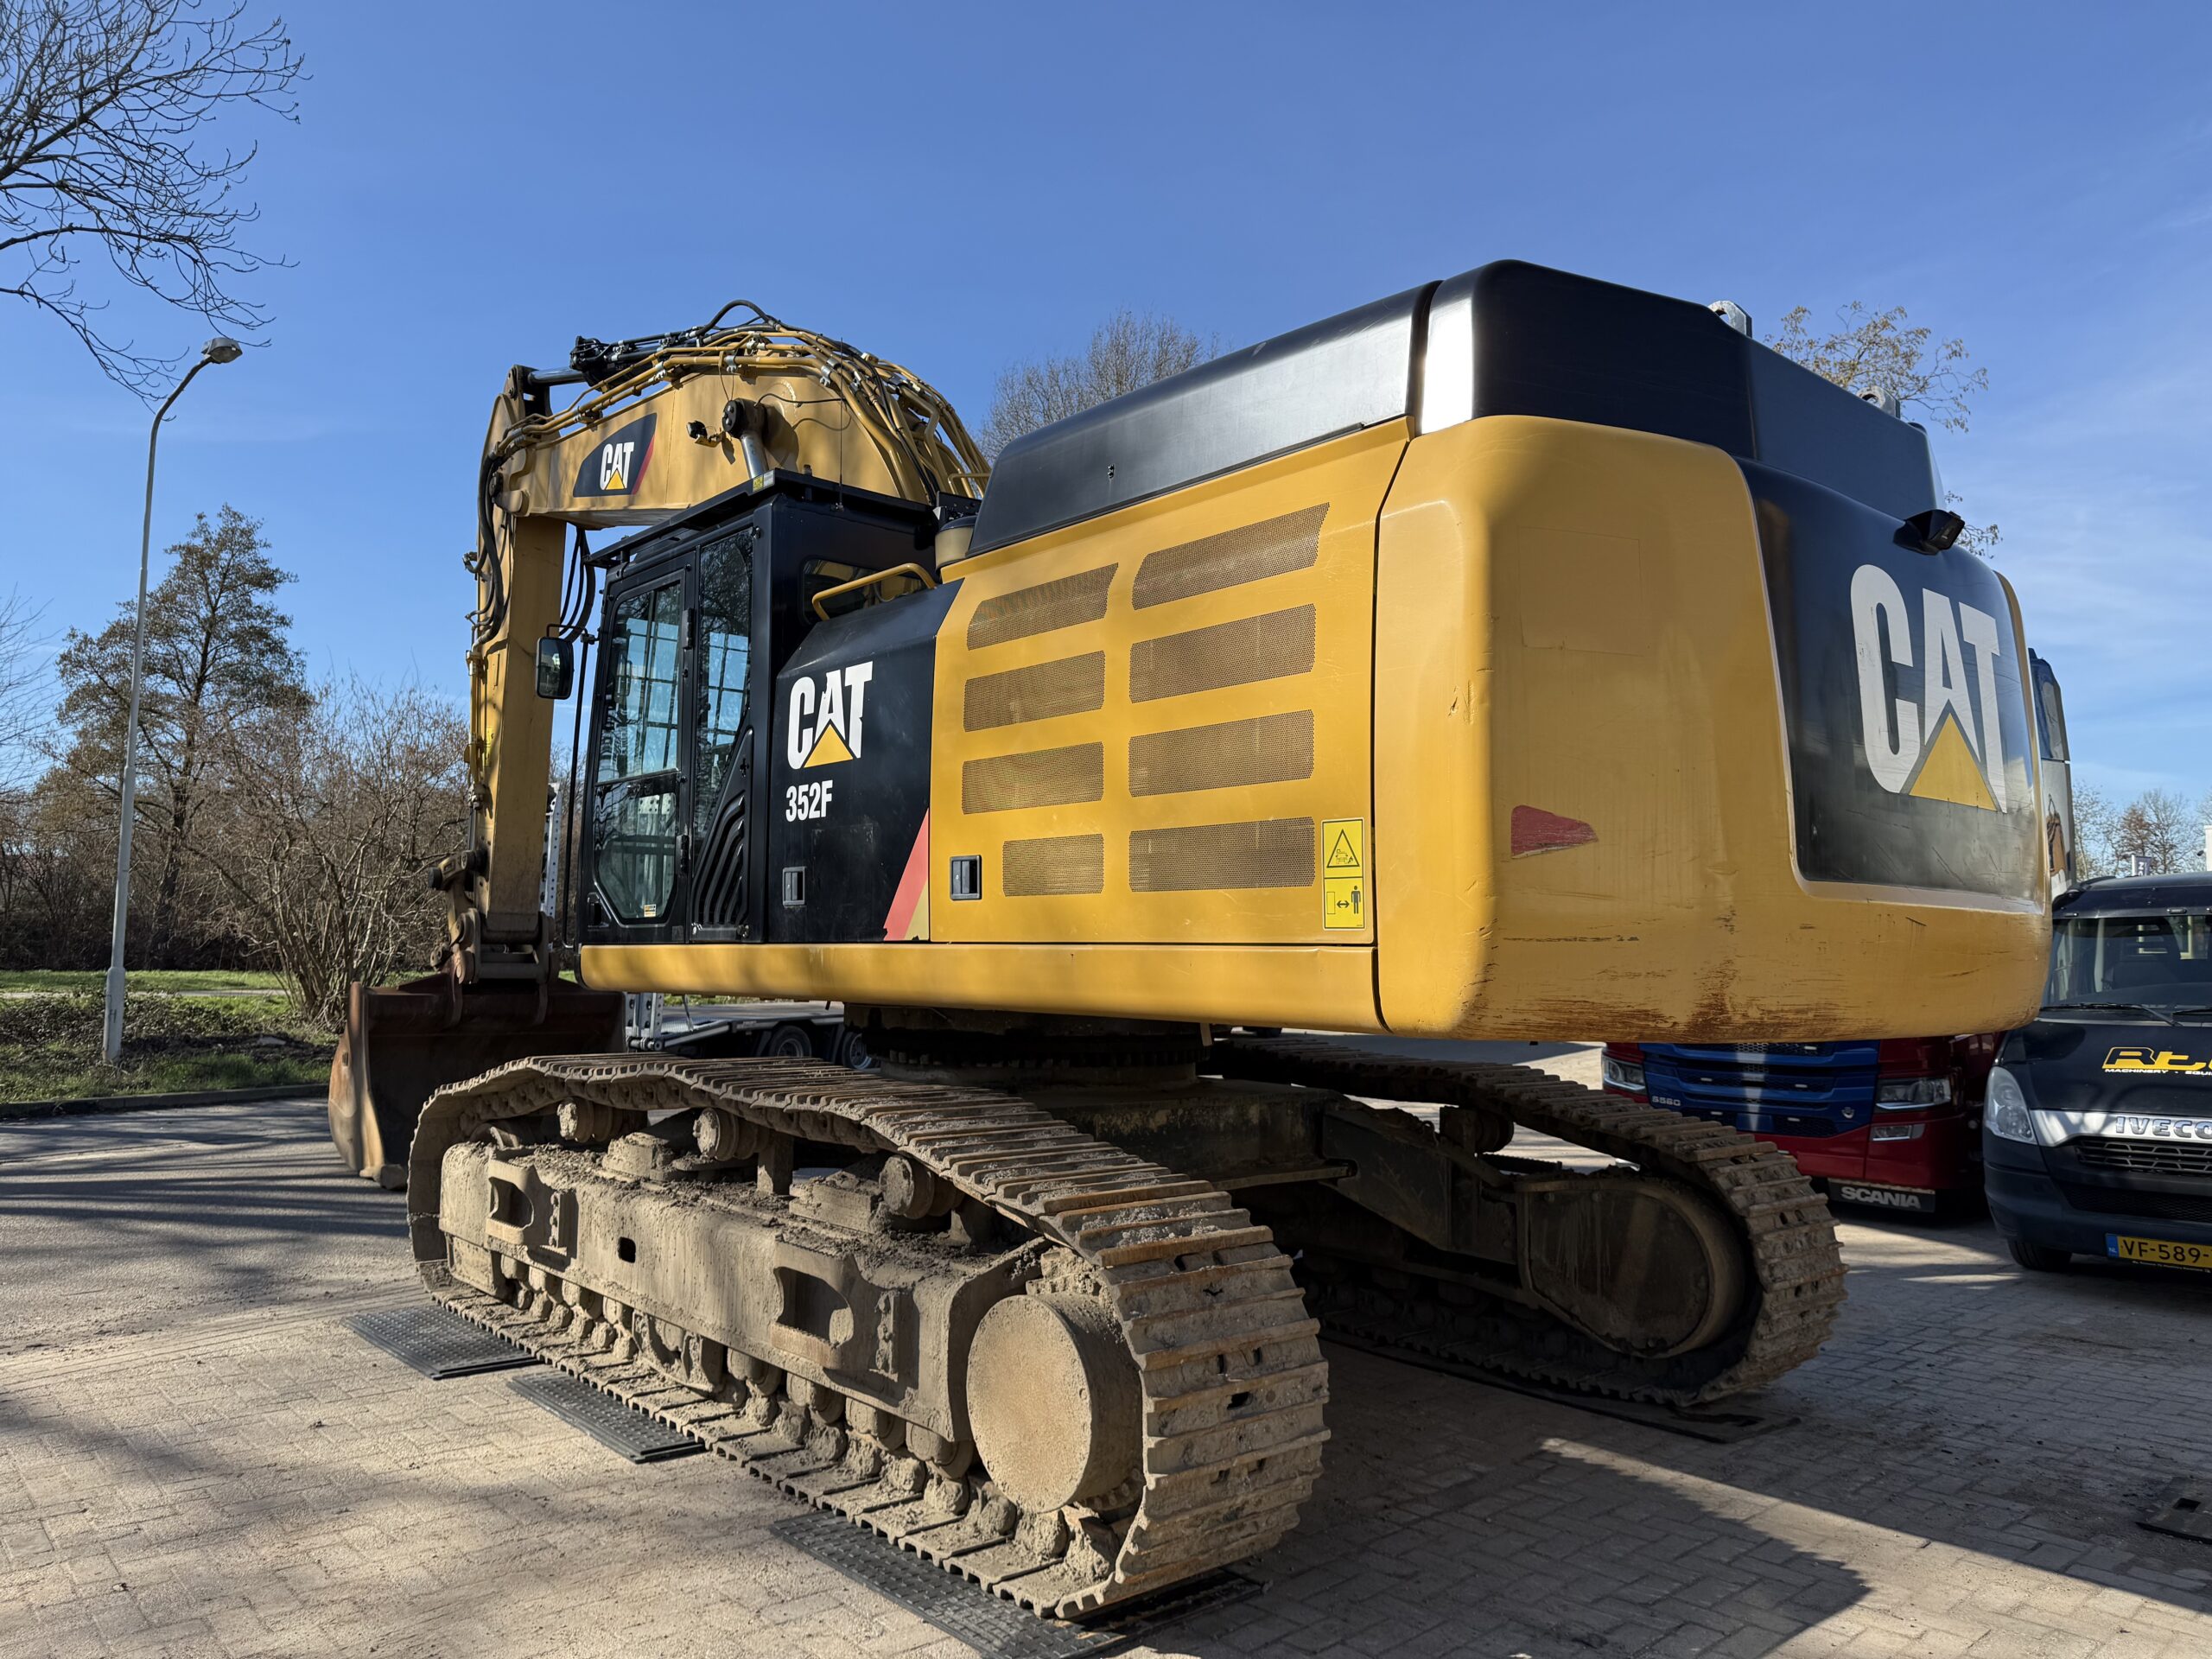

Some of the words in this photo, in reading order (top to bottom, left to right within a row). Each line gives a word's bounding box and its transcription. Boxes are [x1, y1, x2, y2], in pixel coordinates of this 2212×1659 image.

[600, 442, 634, 491] CAT
[1850, 564, 2007, 814] CAT
[787, 661, 874, 770] CAT
[785, 779, 833, 822] 352F
[2115, 1116, 2212, 1140] IVECO
[1840, 1186, 1922, 1209] SCANIA
[2122, 1239, 2212, 1263] VF-589-
